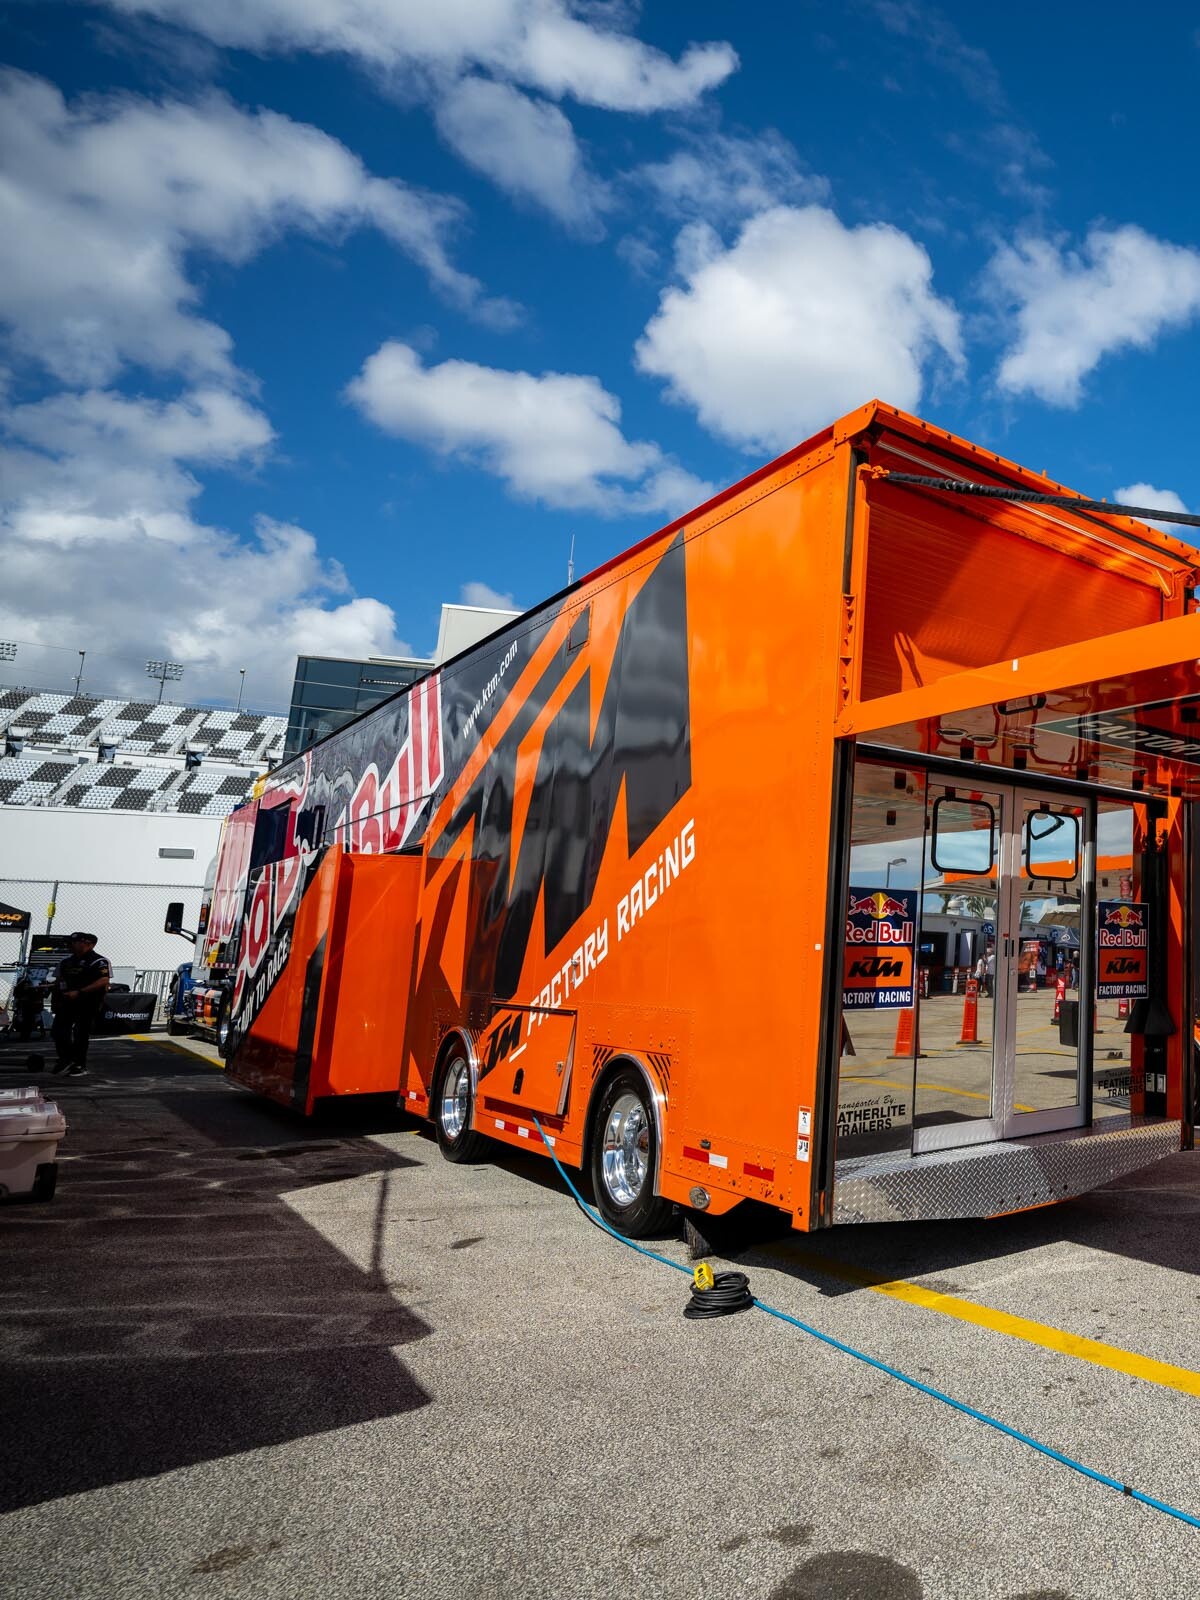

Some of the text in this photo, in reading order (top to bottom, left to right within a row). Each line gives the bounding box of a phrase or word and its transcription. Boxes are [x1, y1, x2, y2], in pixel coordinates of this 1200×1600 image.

[462, 639, 518, 740] www.ktm.com
[878, 921, 914, 944] Bull
[1099, 928, 1147, 947] Red Bull
[266, 931, 289, 992] RACE
[848, 956, 903, 977] KTM
[1105, 957, 1140, 975] KTM
[527, 918, 609, 1037] FACTORY
[843, 990, 911, 1005] ACTORY RACING
[1099, 984, 1147, 995] FACTORY RACING
[838, 1094, 897, 1110] ransported By:
[838, 1104, 906, 1124] ATHERLITE
[836, 1118, 892, 1137] TRAILERS
